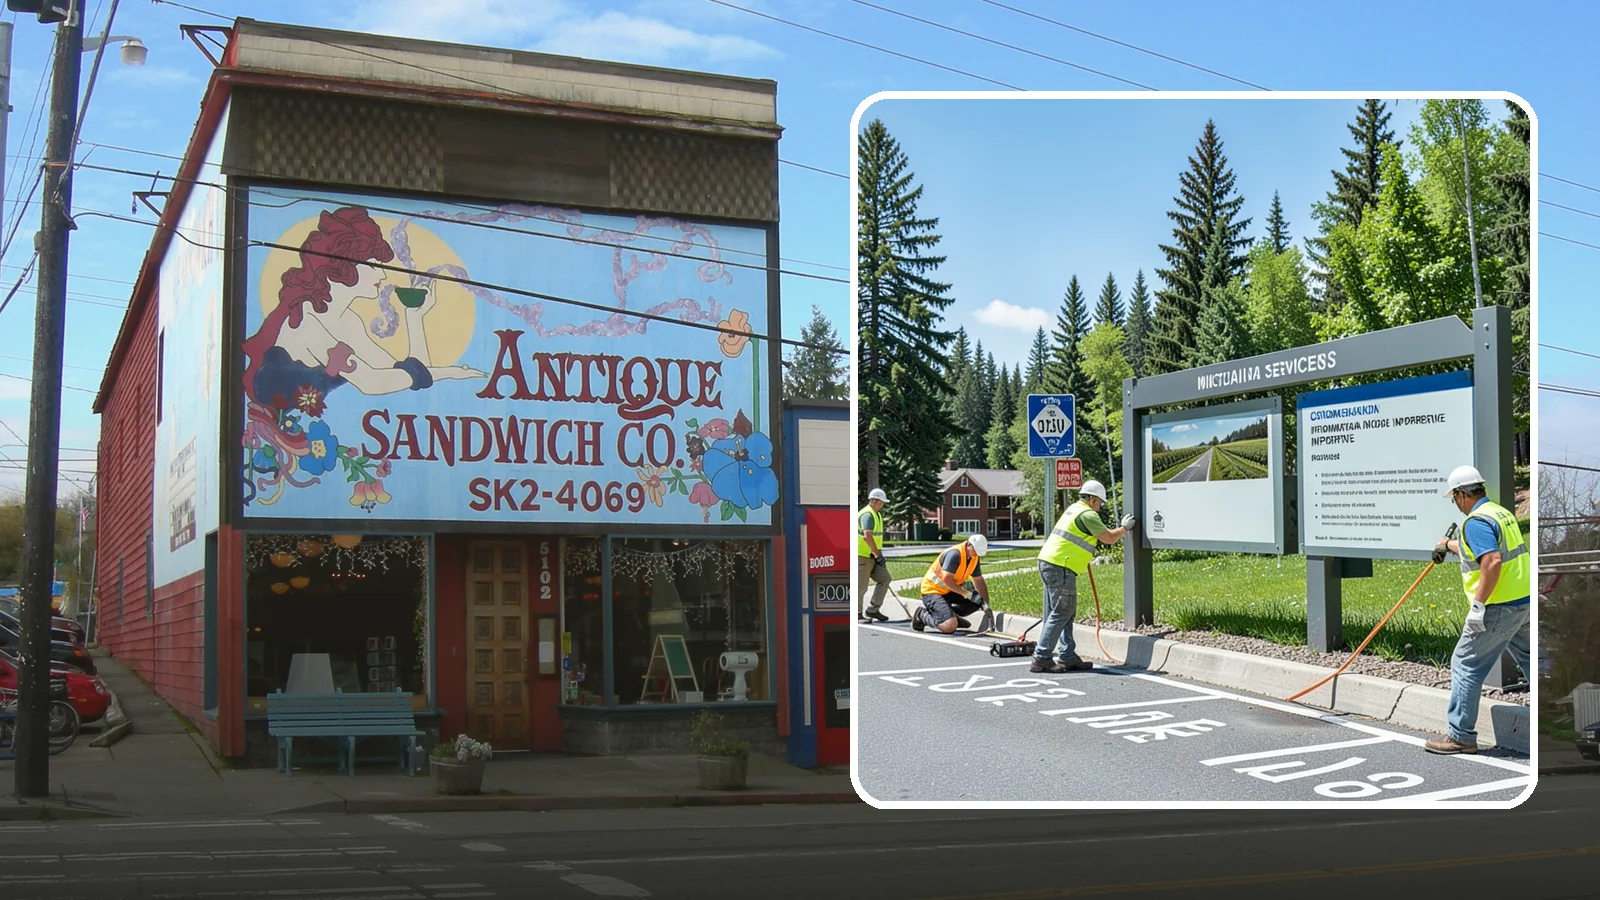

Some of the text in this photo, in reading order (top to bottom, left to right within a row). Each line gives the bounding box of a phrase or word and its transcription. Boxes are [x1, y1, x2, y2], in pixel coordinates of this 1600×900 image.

[476, 329, 723, 421] ANTIQUE
[361, 408, 685, 468] SANDWICH CO.
[469, 476, 646, 513] SK2-4069
[540, 542, 551, 599] 5102
[809, 554, 835, 569] BOOKS
